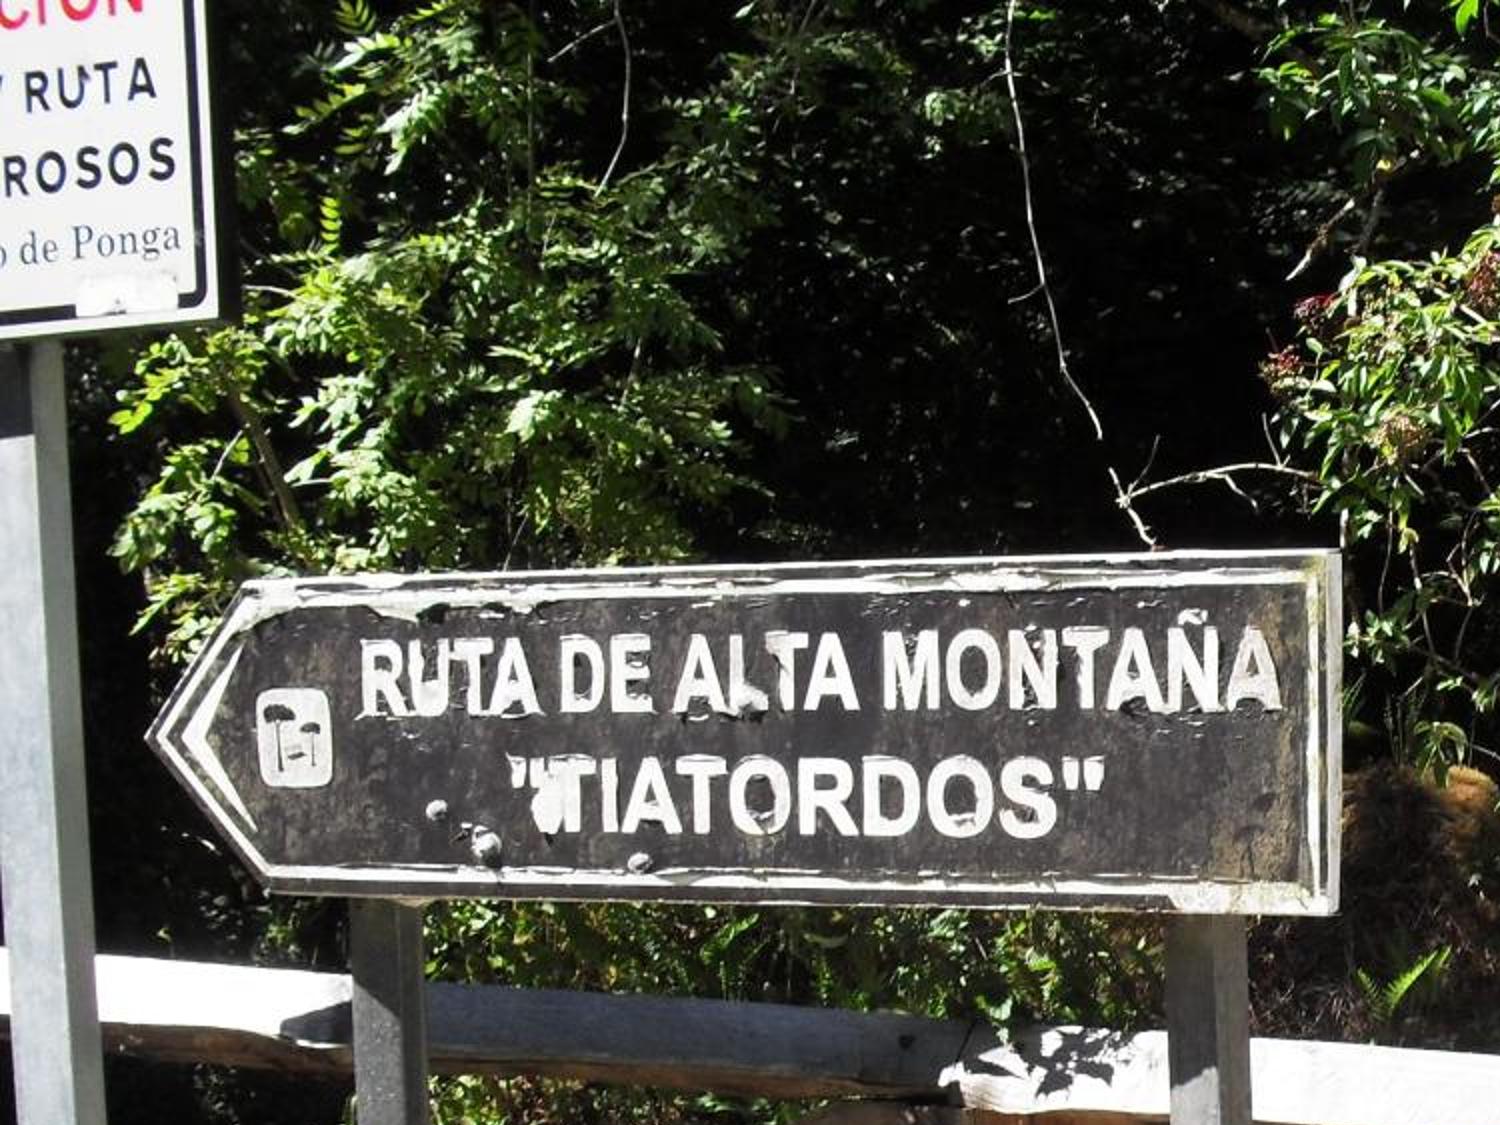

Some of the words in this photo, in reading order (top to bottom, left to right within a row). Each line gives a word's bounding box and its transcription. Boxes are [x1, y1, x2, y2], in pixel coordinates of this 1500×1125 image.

[24, 57, 157, 114] RUTA
[20, 229, 59, 265] de
[72, 224, 181, 261] Ponga
[359, 635, 543, 718] RUTA
[559, 633, 654, 714] DE
[673, 630, 861, 717] ALTA
[882, 609, 1282, 714] MONTAÑA
